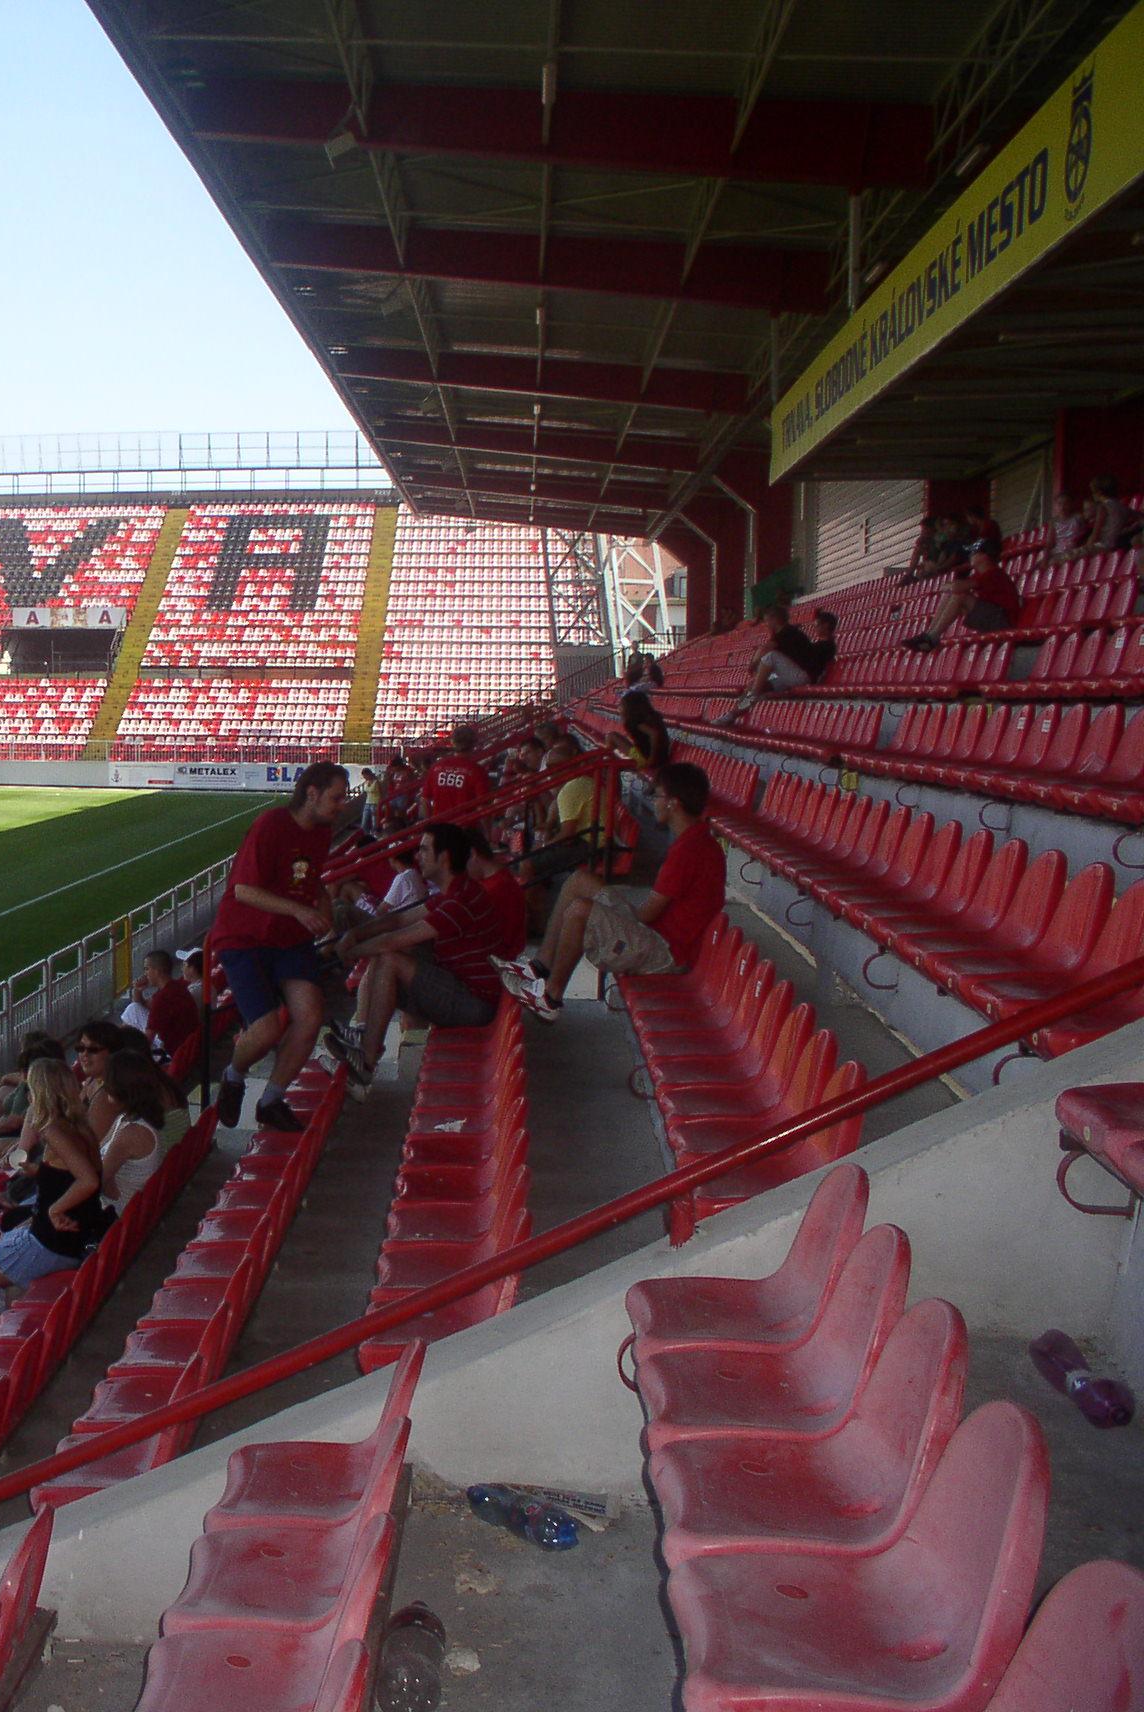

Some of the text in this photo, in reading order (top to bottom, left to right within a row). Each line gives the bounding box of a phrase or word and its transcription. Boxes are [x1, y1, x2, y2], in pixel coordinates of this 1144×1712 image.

[965, 147, 1049, 284] MESTO
[25, 610, 112, 625] A A
[189, 767, 237, 776] METALEX
[437, 772, 465, 788] 666
